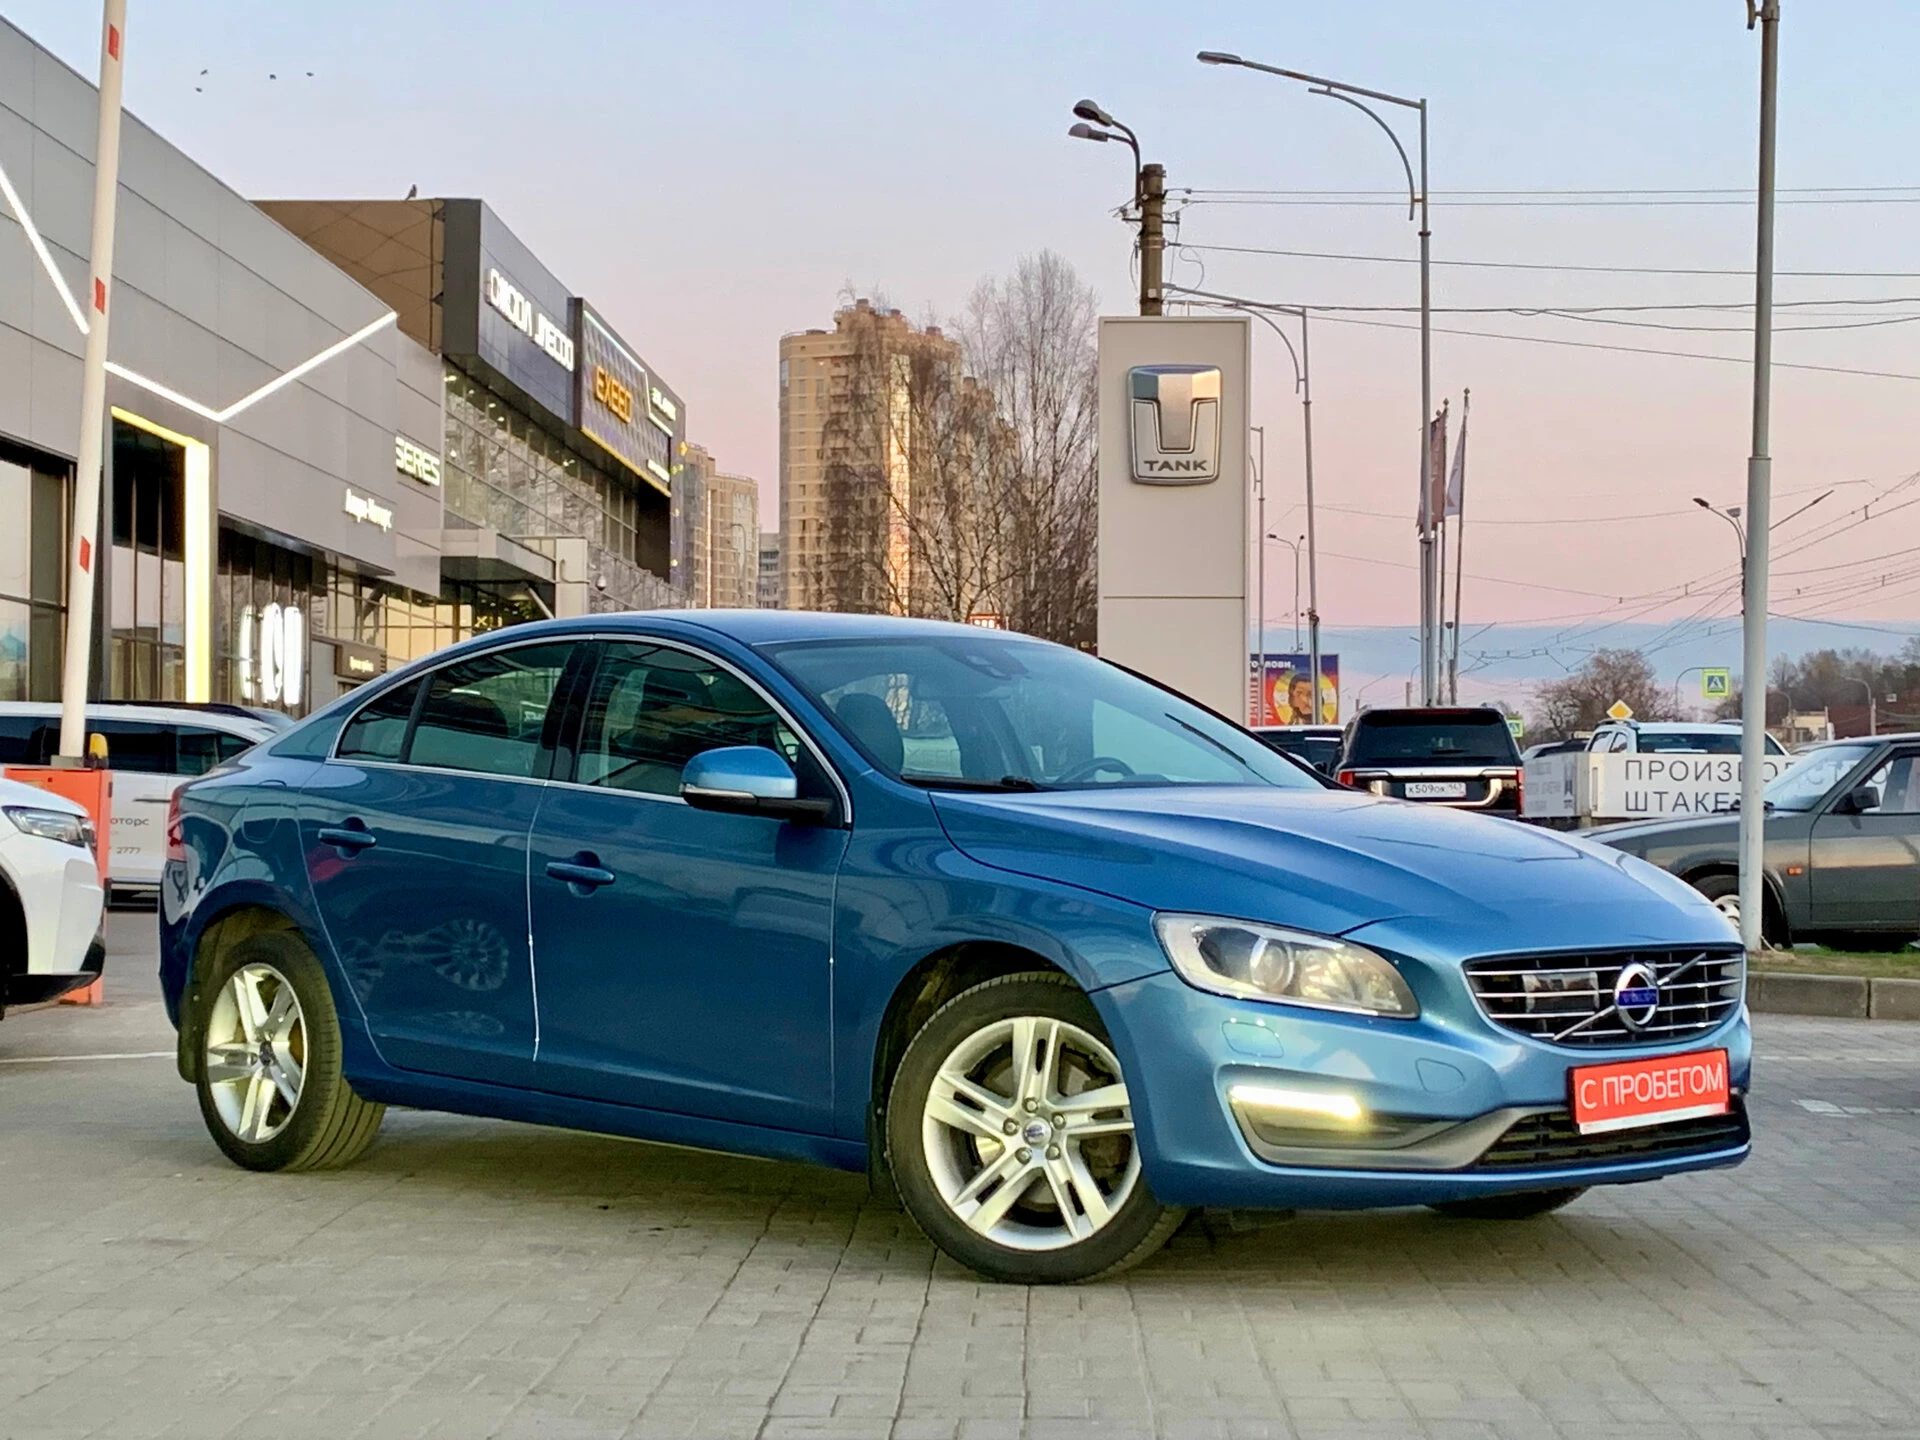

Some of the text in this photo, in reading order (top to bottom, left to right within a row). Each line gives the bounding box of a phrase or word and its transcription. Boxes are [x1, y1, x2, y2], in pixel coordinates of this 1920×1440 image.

[595, 366, 632, 424] EXEED
[395, 436, 440, 487] SERES
[1143, 460, 1207, 471] TANK
[1625, 791, 1741, 813] ШТАКЕ
[110, 817, 149, 827] оторс
[1580, 1062, 1724, 1109] С ПРОБЕГОМ
